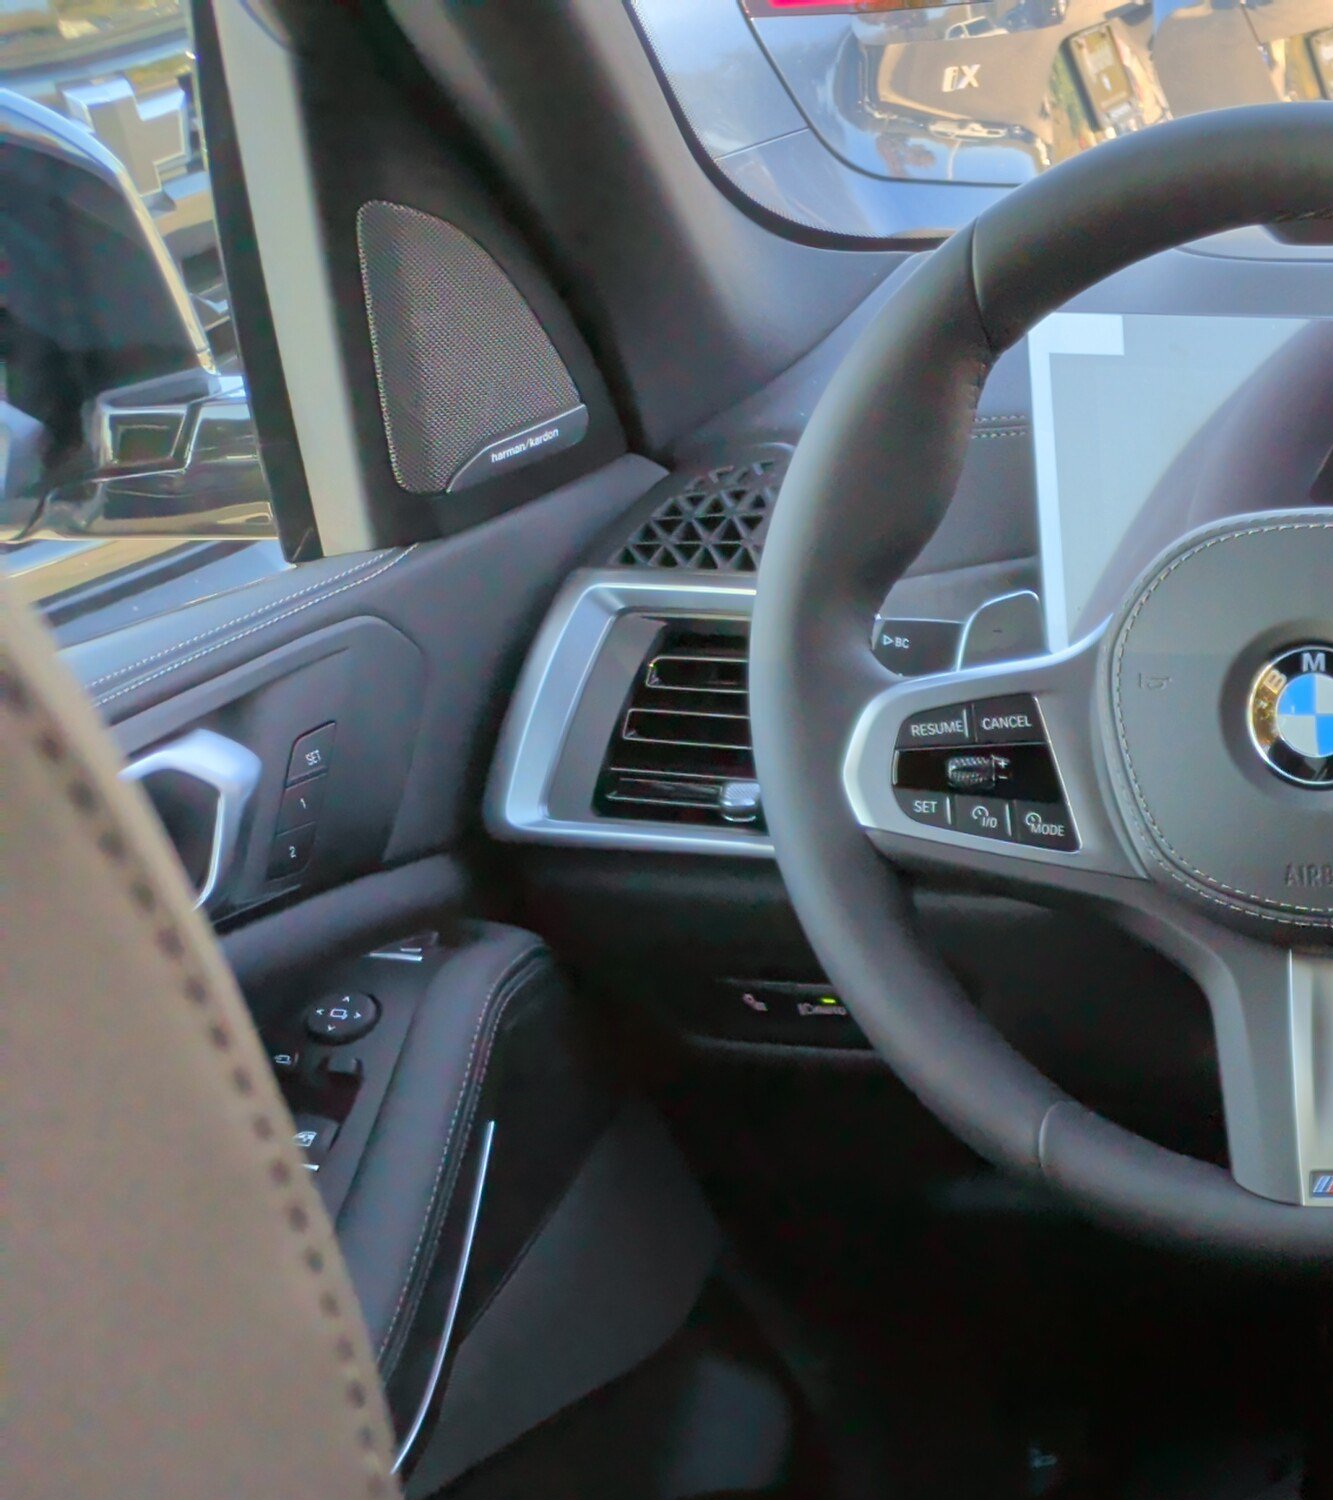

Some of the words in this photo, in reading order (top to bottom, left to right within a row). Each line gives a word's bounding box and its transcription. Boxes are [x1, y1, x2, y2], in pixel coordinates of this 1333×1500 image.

[491, 428, 559, 463] harman/kardon
[894, 637, 910, 649] BC
[911, 719, 964, 738] RESUME
[982, 715, 1032, 731] CANCEL
[913, 800, 938, 814] SET
[1031, 823, 1065, 837] MODE
[289, 846, 297, 858] 2
